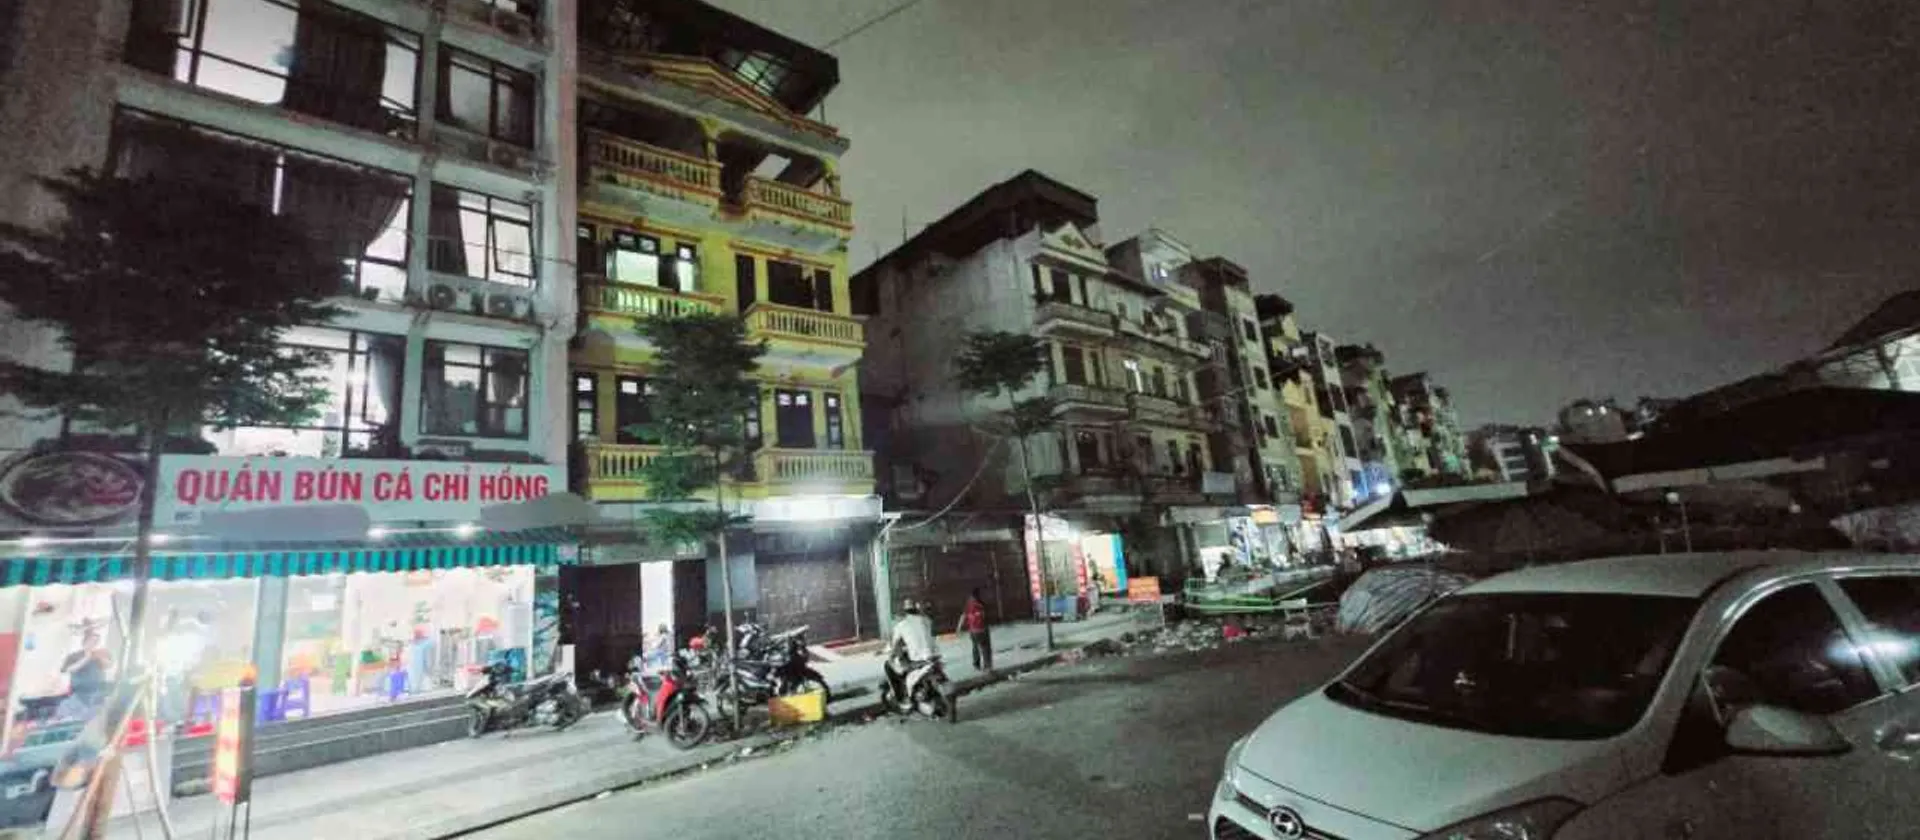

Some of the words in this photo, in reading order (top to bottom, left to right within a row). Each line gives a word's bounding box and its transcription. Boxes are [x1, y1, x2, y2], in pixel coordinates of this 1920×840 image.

[176, 463, 281, 504] QUÁN
[293, 465, 362, 501] BÚN
[373, 467, 413, 501] CÁ
